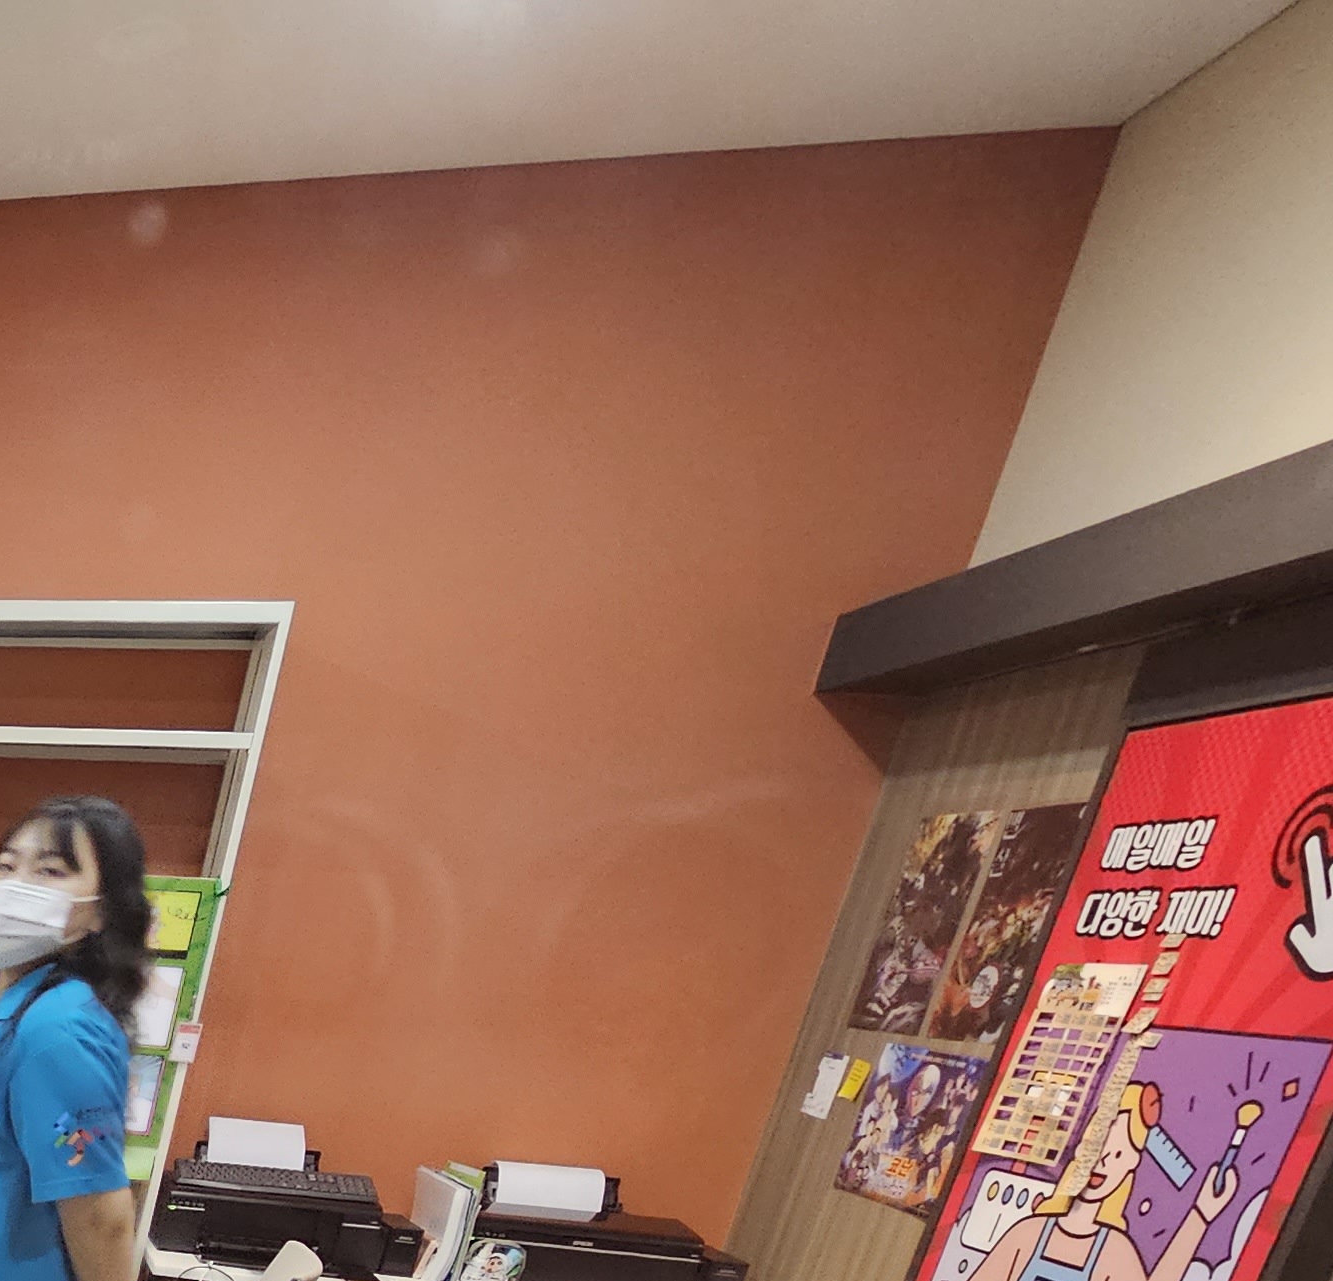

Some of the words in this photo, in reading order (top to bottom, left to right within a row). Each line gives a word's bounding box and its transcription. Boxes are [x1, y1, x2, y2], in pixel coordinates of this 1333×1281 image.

[1100, 818, 1216, 871] 매일매일
[1076, 888, 1158, 938] 다양한
[1159, 886, 1236, 938] 재미!
